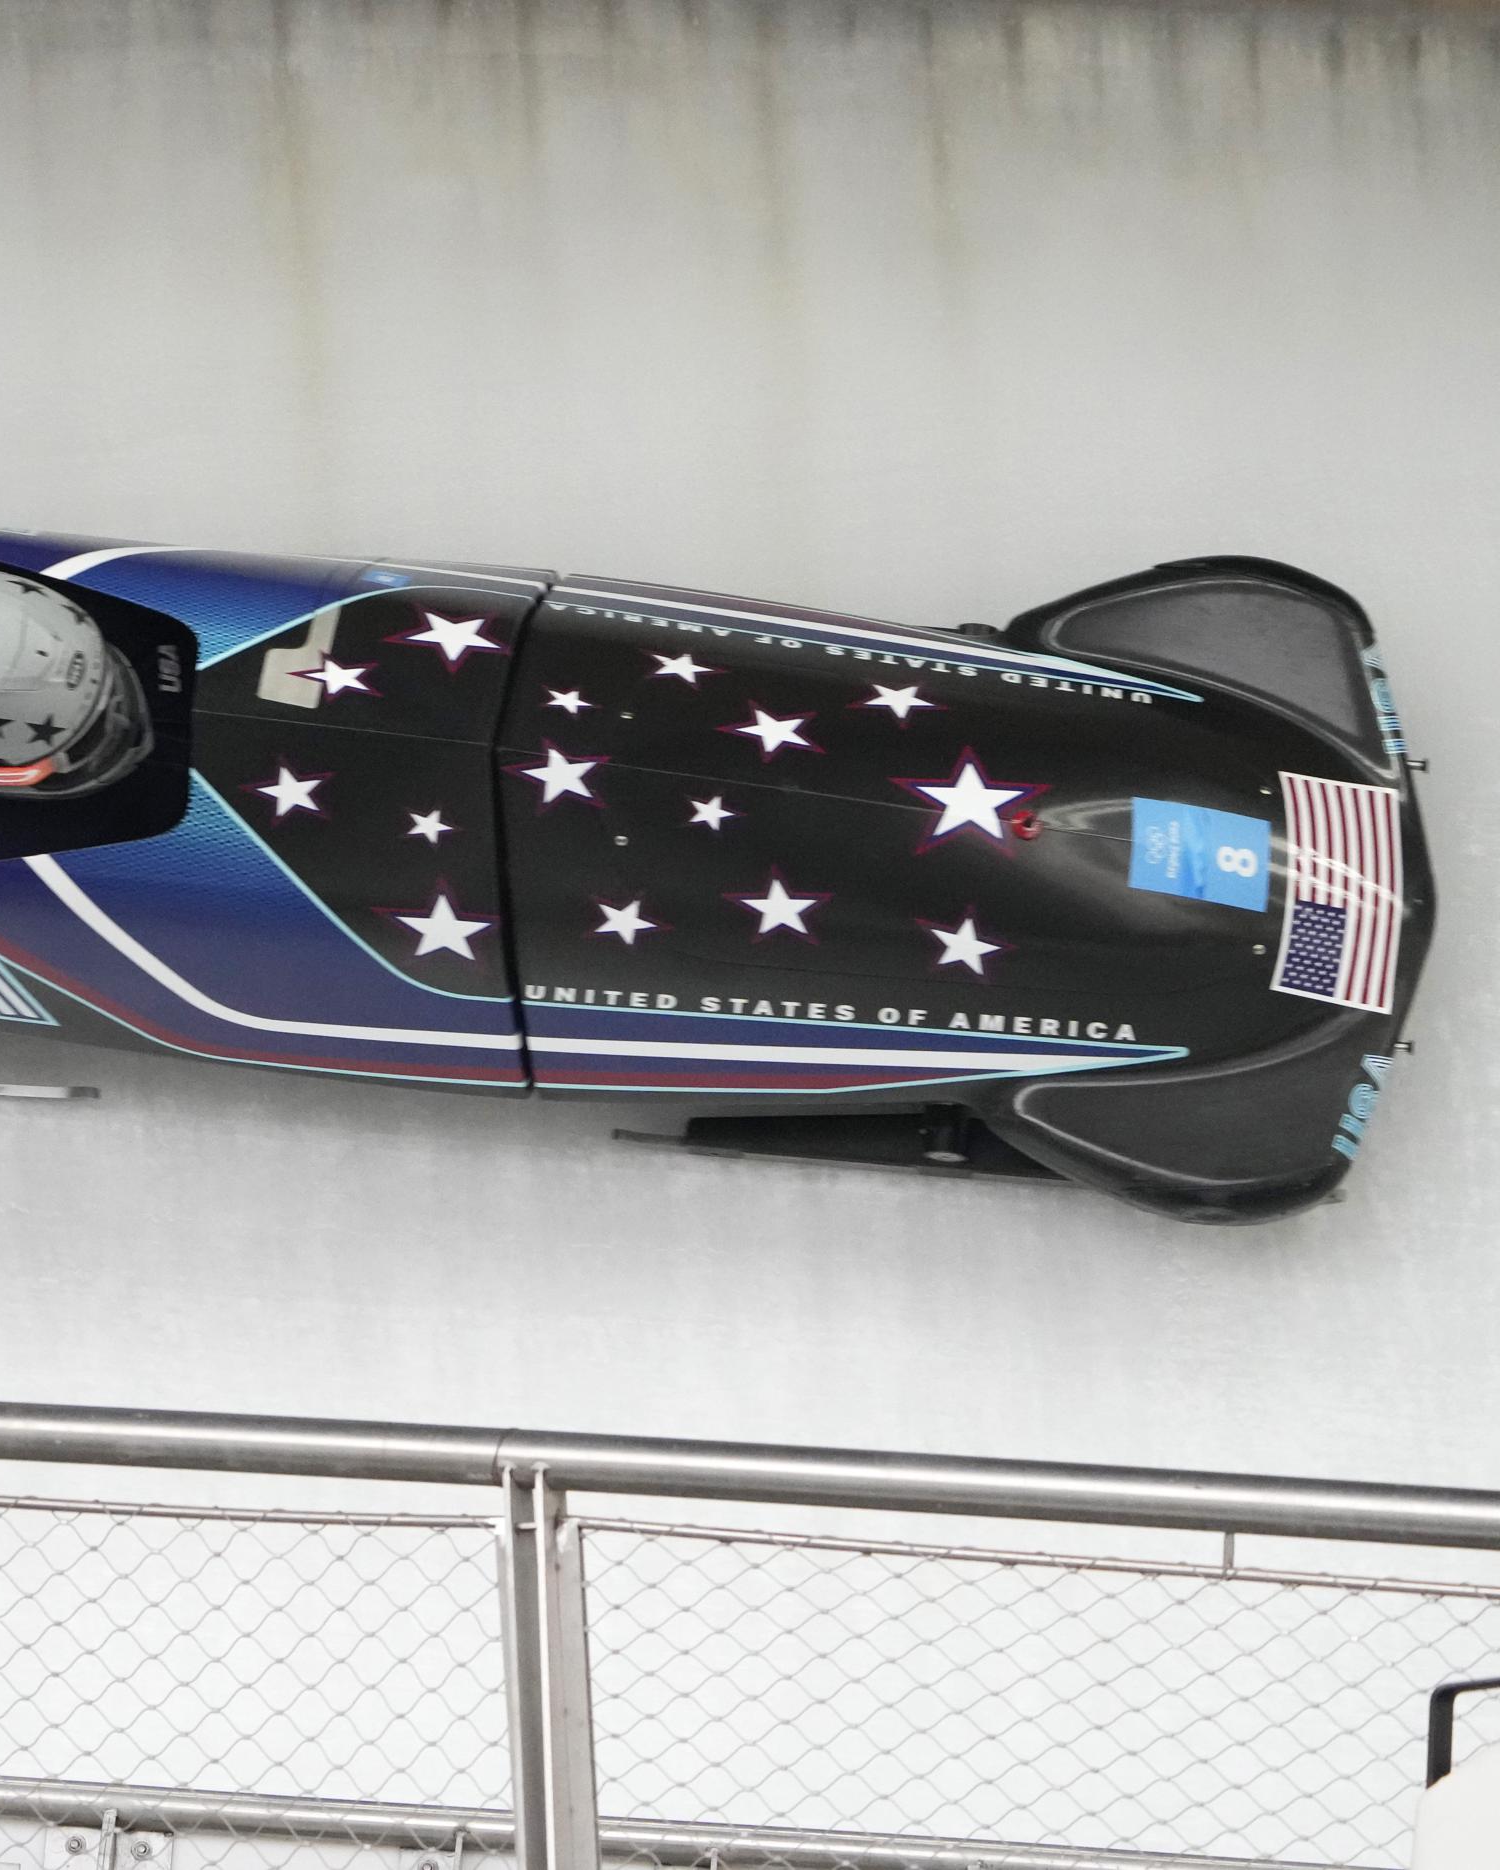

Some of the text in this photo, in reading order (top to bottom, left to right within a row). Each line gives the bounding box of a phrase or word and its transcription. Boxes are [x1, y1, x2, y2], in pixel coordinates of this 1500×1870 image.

[157, 645, 182, 692] USA
[549, 603, 1153, 704] UNITED STATES OF AMERICA
[1217, 846, 1258, 877] 8
[524, 984, 1137, 1041] UNITED STATES OF AMERICA
